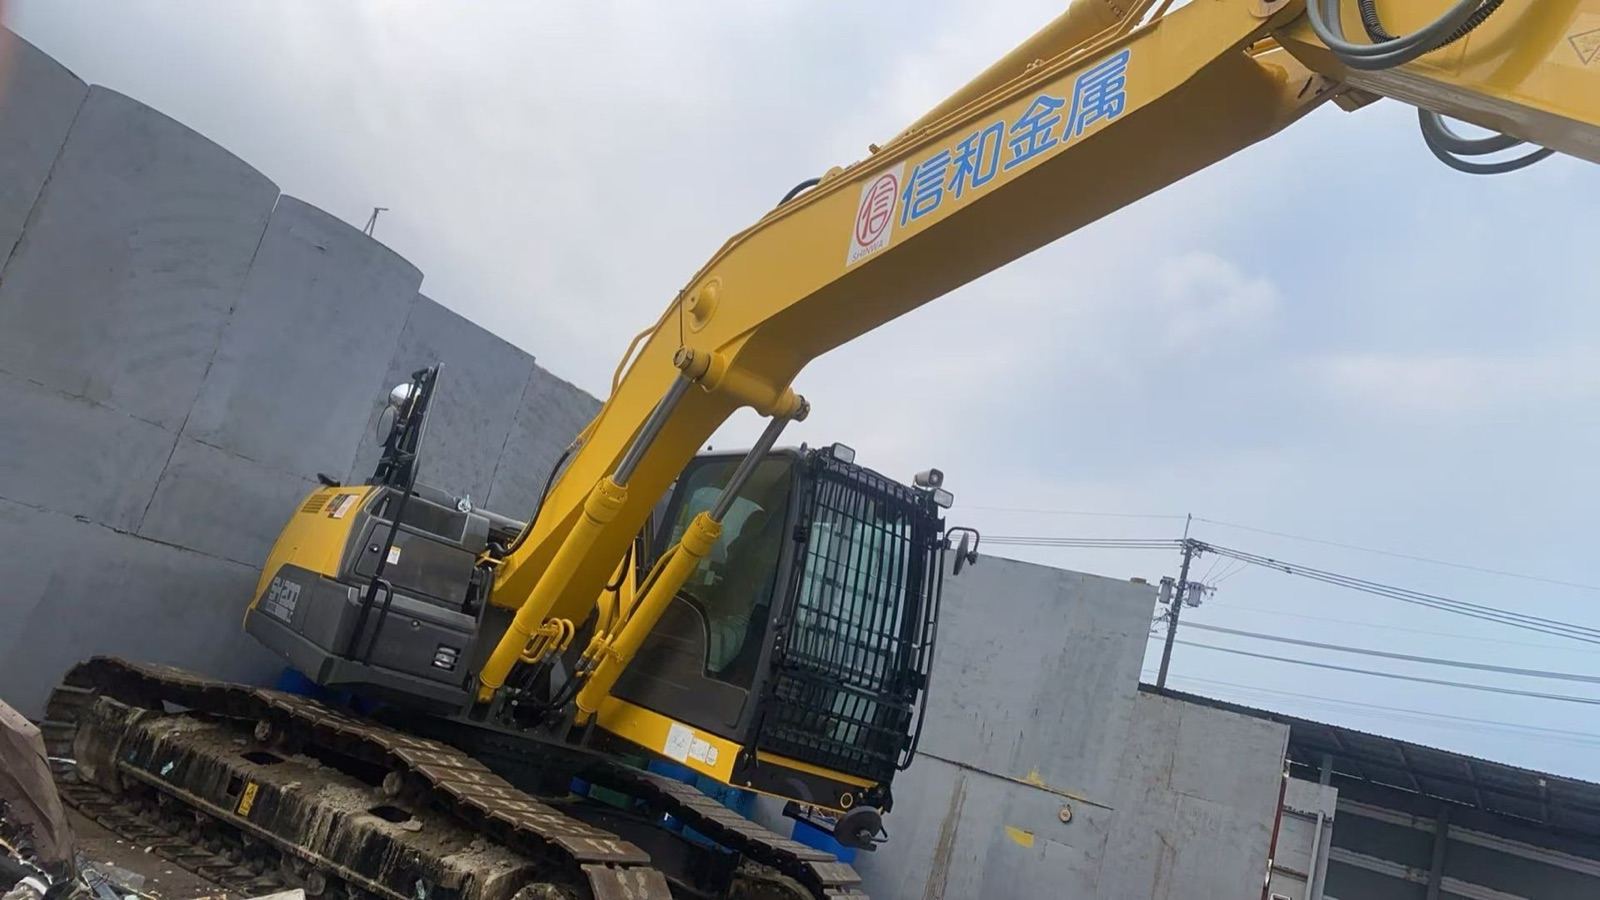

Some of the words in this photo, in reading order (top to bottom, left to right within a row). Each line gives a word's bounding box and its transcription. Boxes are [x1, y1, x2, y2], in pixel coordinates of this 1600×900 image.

[901, 48, 1130, 227] 信和金属
[860, 178, 895, 242] 信
[852, 240, 883, 261] SHINWA
